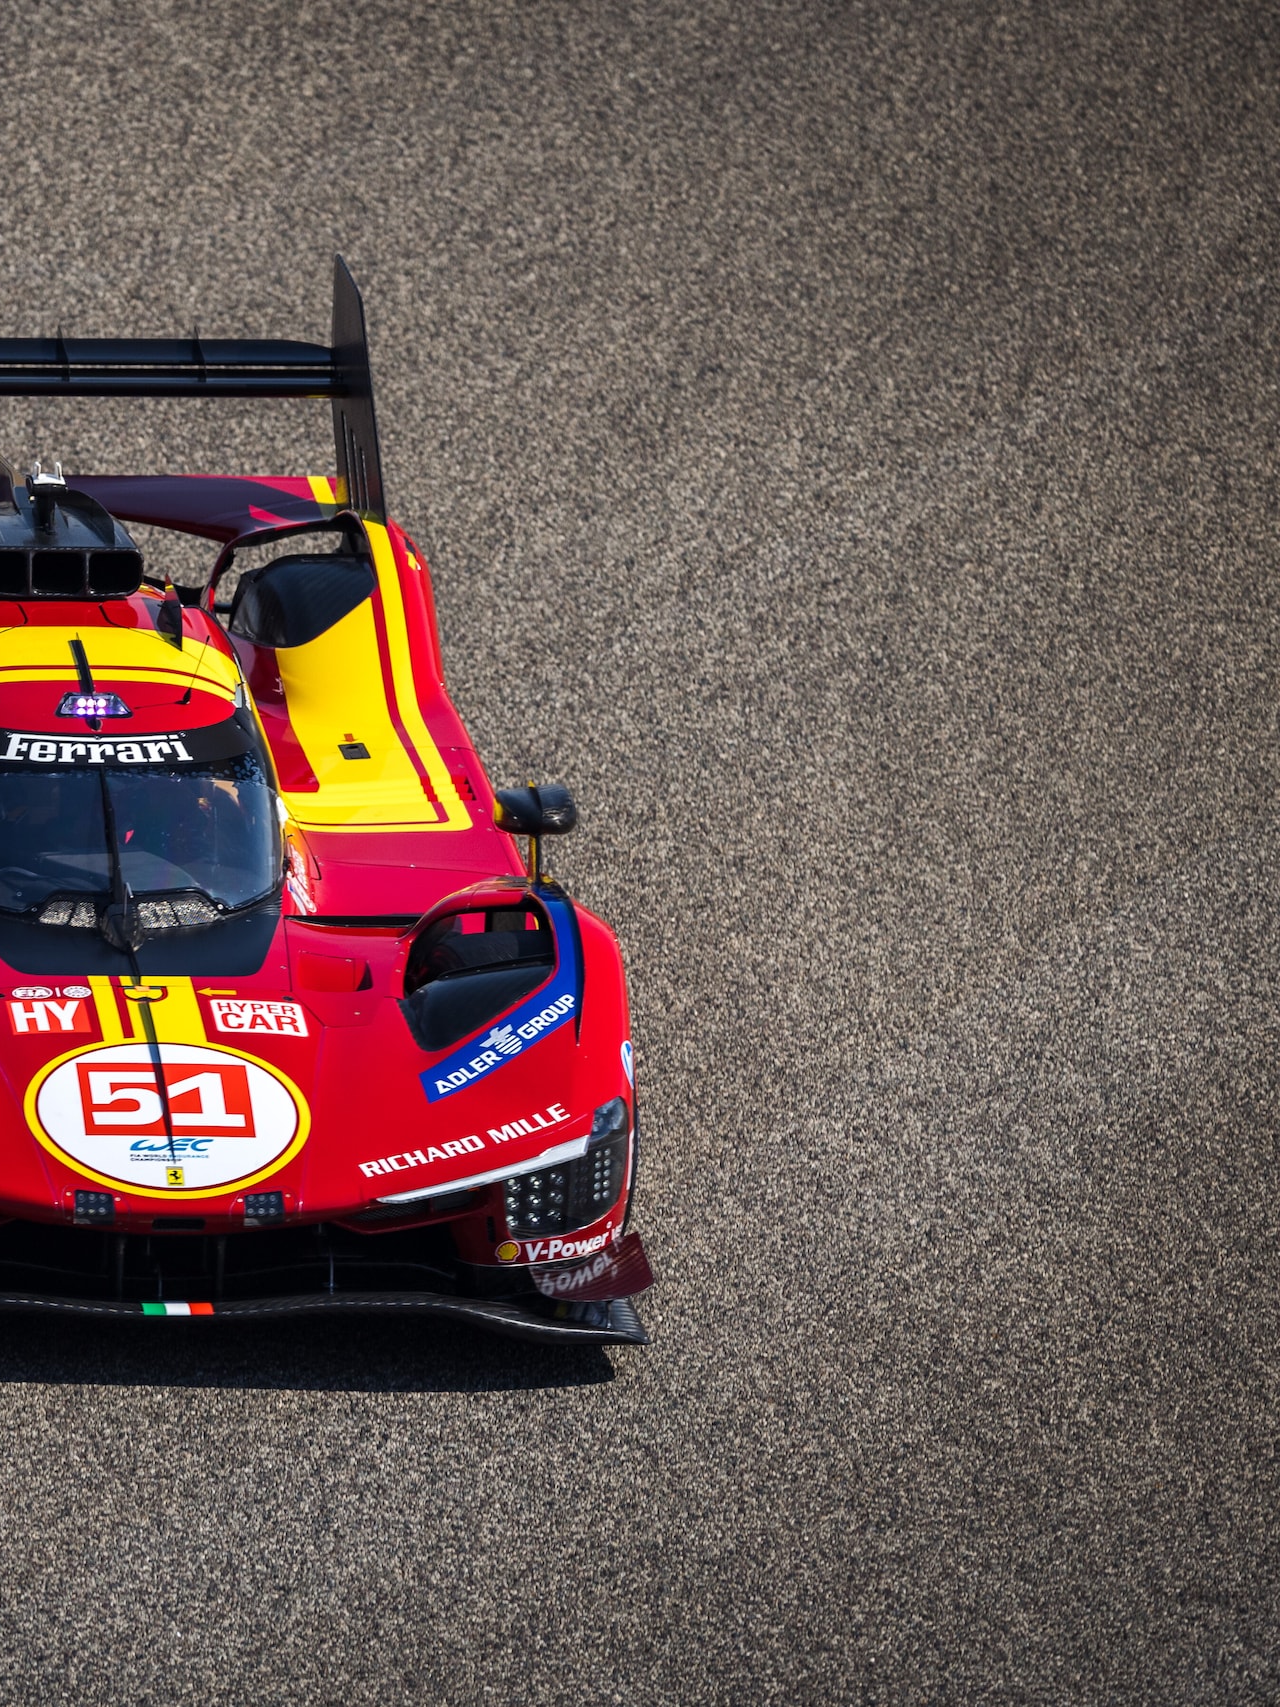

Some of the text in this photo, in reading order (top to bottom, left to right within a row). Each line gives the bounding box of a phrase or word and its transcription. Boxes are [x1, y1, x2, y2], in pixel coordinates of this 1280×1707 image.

[0, 733, 193, 763] Ferrari
[10, 1001, 80, 1032] HY
[217, 1001, 297, 1016] HYPER
[221, 1012, 301, 1033] CAR
[434, 993, 576, 1095] ADLER GROUP
[87, 1071, 247, 1128] 51
[130, 1138, 214, 1151] WEC
[358, 1102, 571, 1179] RICHARD MILLE
[525, 1231, 609, 1261] V-Power
